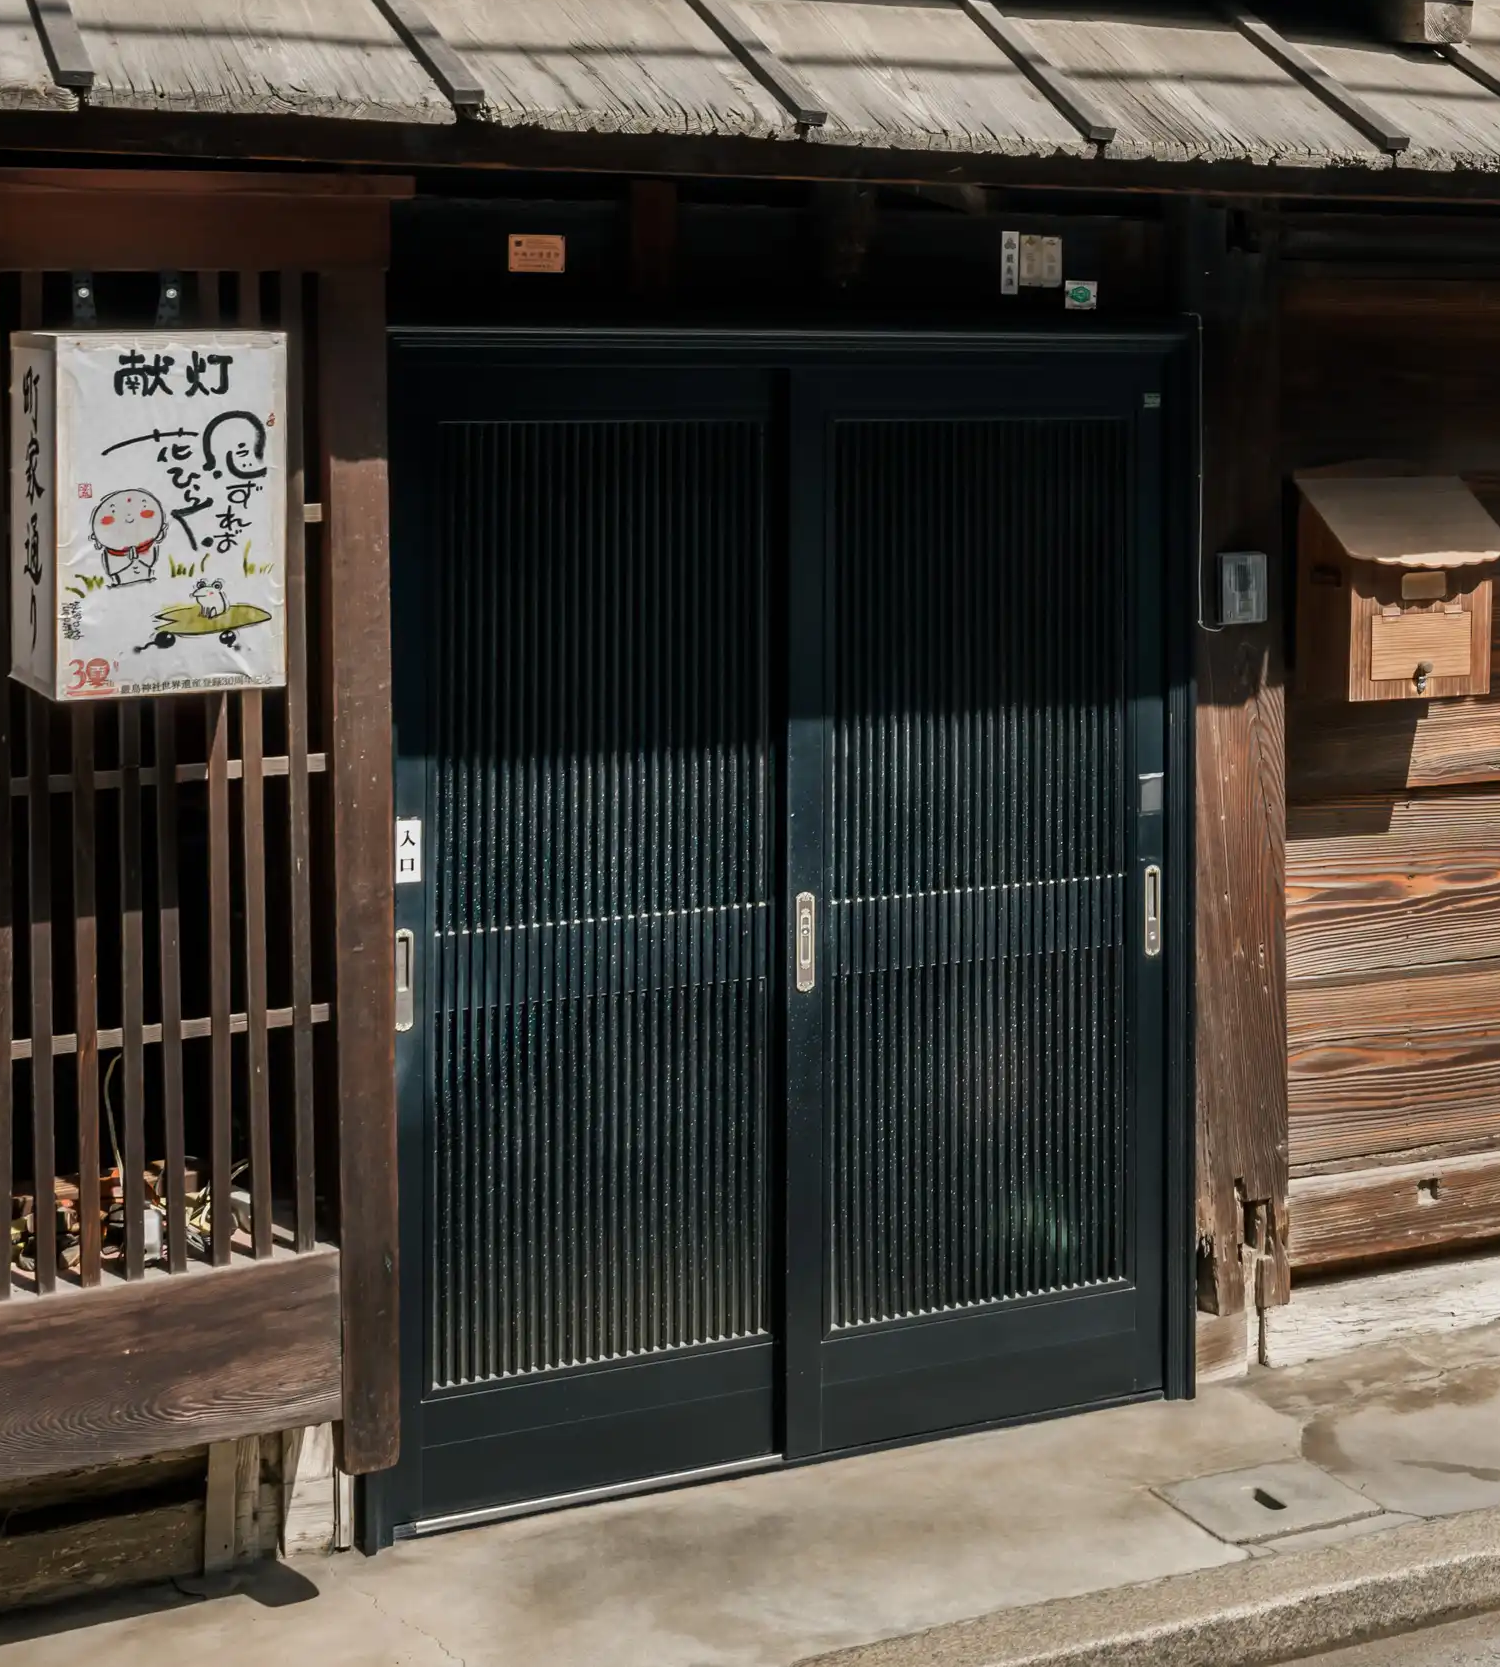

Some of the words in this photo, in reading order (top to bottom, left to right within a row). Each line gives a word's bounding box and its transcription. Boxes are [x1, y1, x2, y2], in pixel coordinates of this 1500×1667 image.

[114, 349, 234, 397] 献灯
[22, 365, 46, 654] 町家通り
[400, 830, 416, 872] 入口
